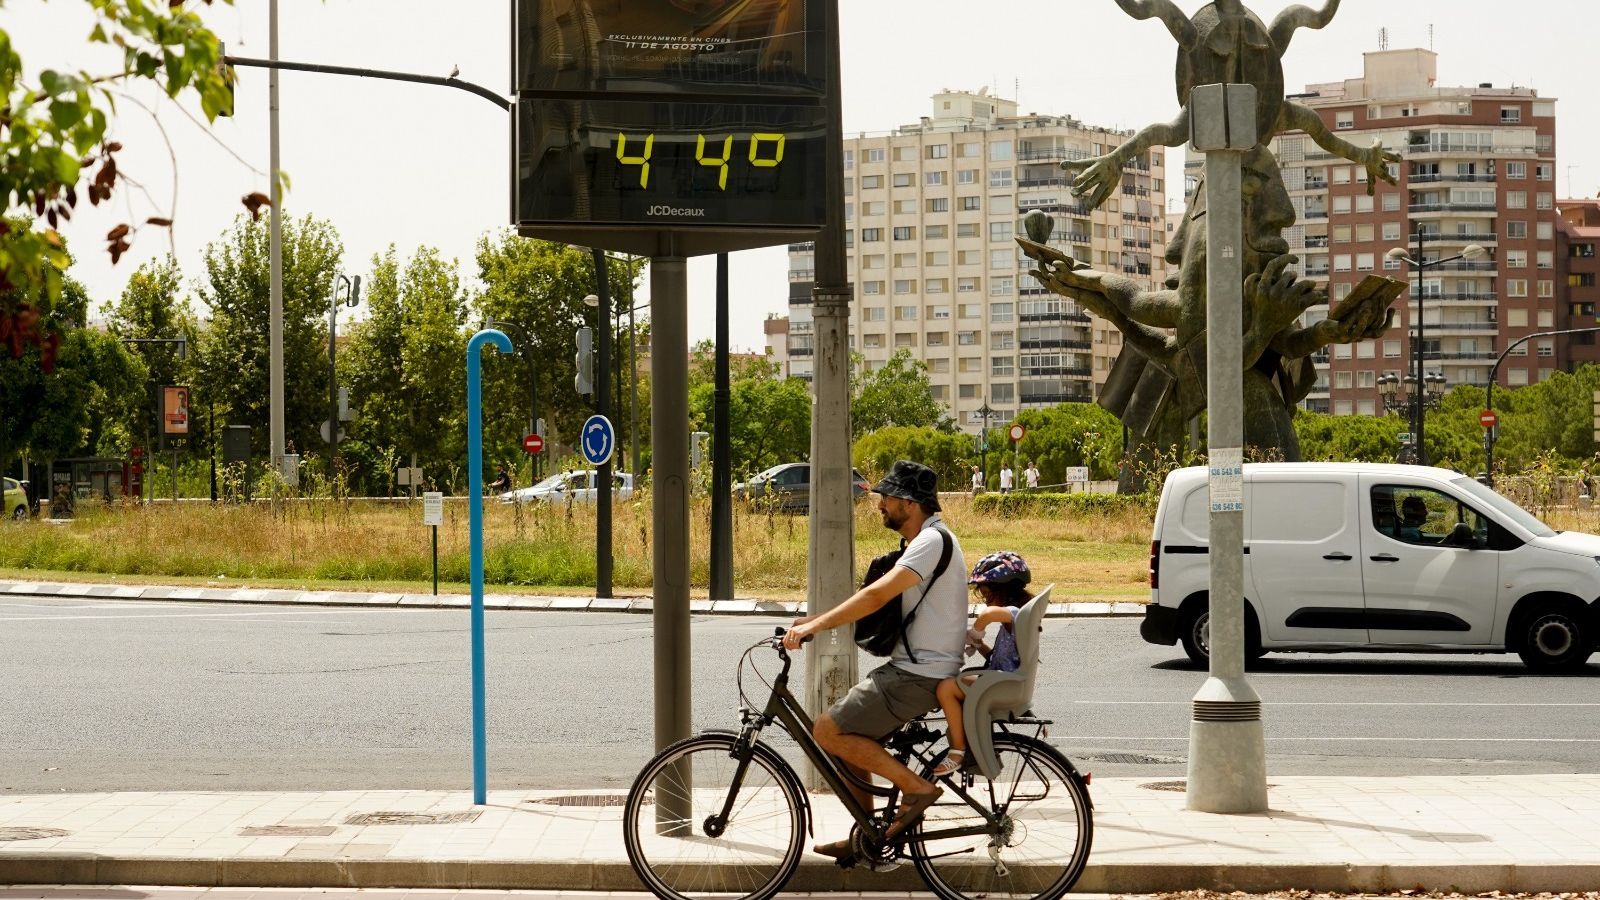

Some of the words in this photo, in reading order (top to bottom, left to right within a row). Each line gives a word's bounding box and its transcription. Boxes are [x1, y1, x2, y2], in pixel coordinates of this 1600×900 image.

[609, 34, 687, 42] EXCLUSIVAMENTE
[663, 43, 715, 51] AGOSTO
[646, 205, 705, 217] JCDecaux
